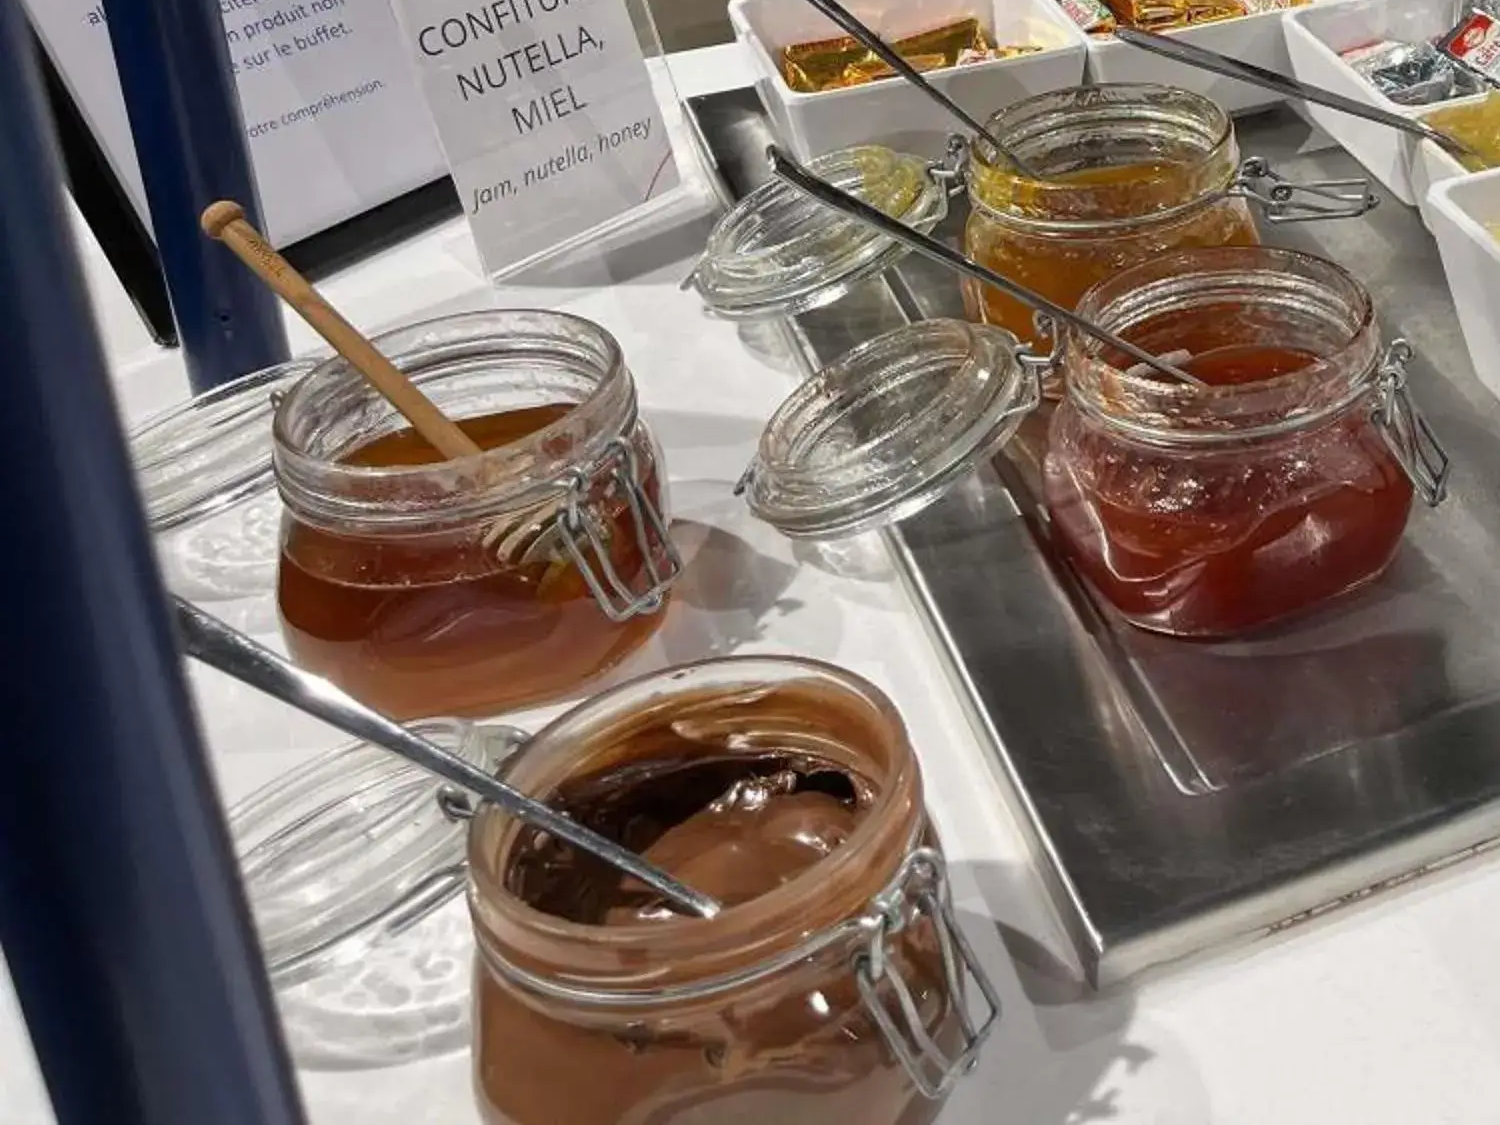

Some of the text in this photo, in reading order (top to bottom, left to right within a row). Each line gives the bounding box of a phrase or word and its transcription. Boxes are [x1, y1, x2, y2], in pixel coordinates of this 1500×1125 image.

[242, 50, 271, 70] sur
[273, 43, 293, 58] le
[293, 22, 354, 52] buffet.
[243, 4, 310, 41] produit
[456, 26, 604, 102] NUTELLA,
[511, 85, 588, 134] MIEL
[471, 118, 652, 215] Jam, nutella, honey
